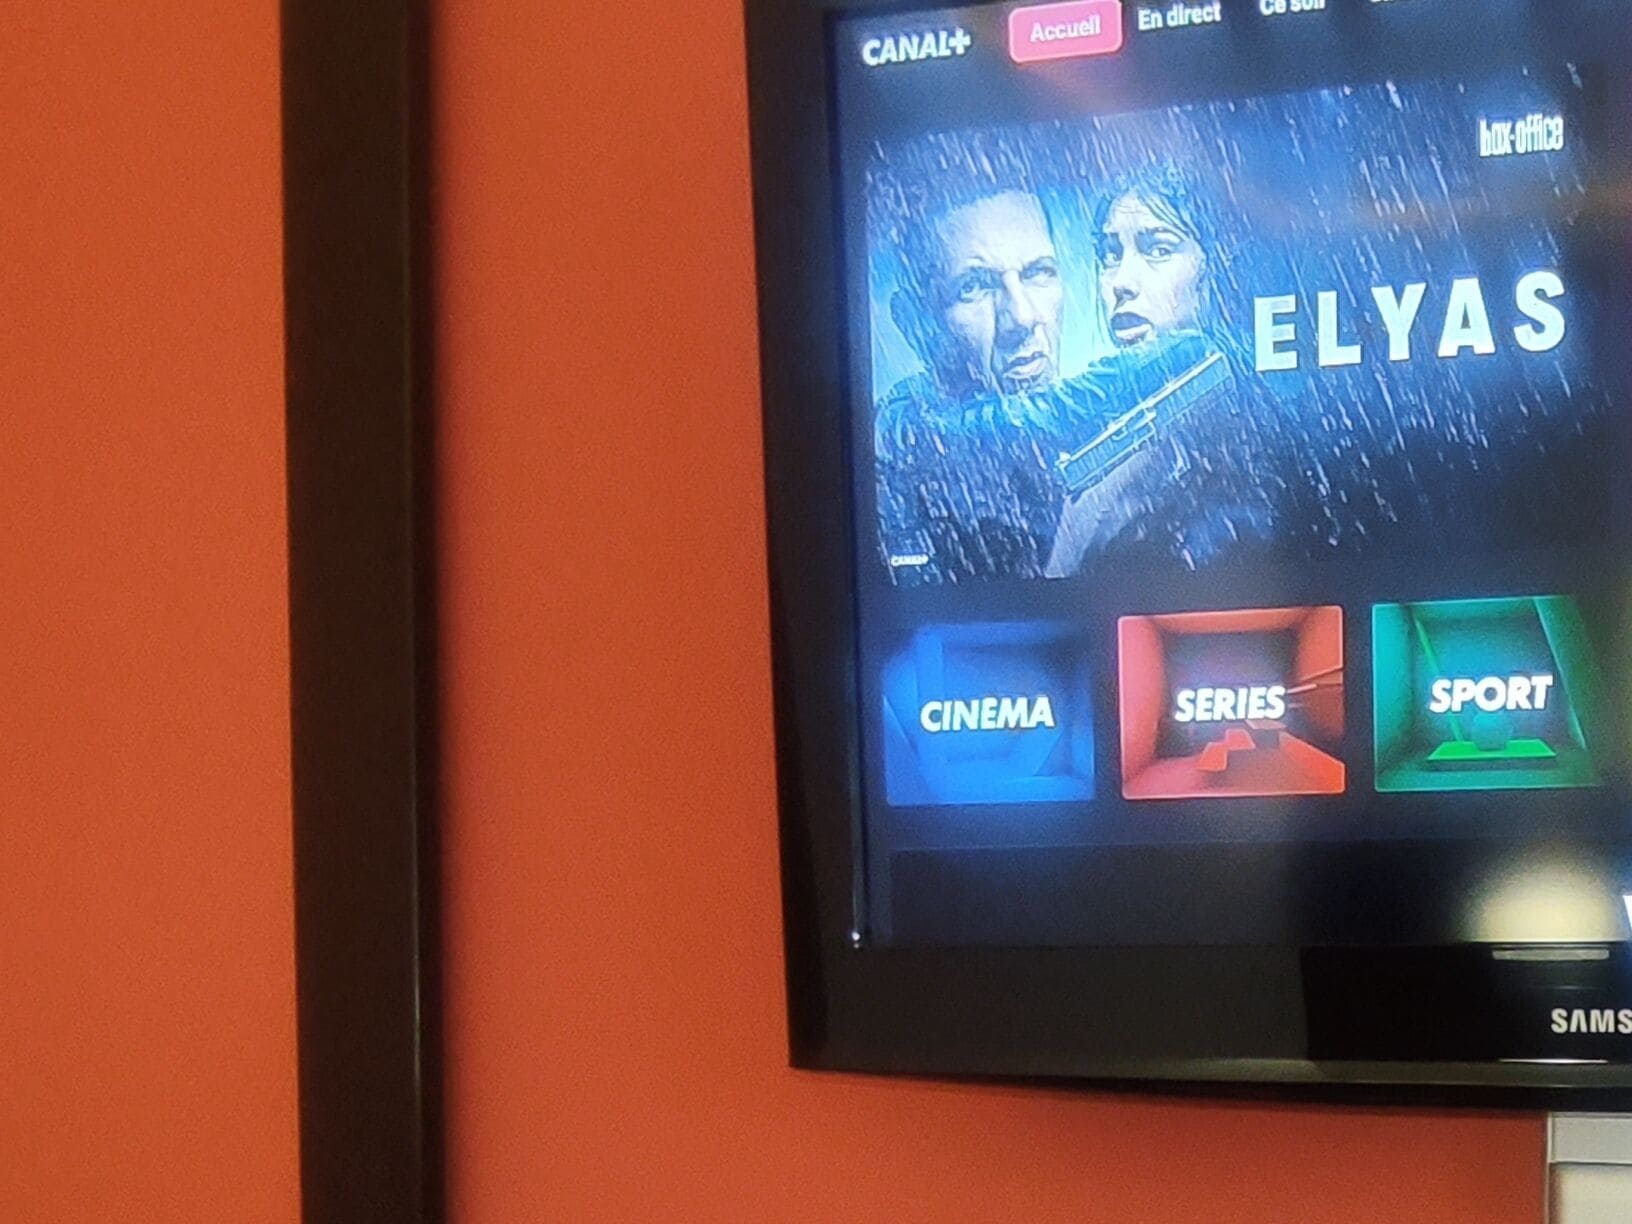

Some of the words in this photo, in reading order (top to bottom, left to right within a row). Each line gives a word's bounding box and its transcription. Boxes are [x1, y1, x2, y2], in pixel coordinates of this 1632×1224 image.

[1029, 14, 1101, 43] Accueil
[1137, 8, 1163, 31] En
[1166, 1, 1222, 28] direct
[862, 27, 971, 66] CANAL+
[1252, 270, 1567, 373] ELYAS
[1174, 685, 1287, 724] SERIES
[1429, 674, 1554, 714] SPORT
[920, 695, 1056, 733] CINEMA
